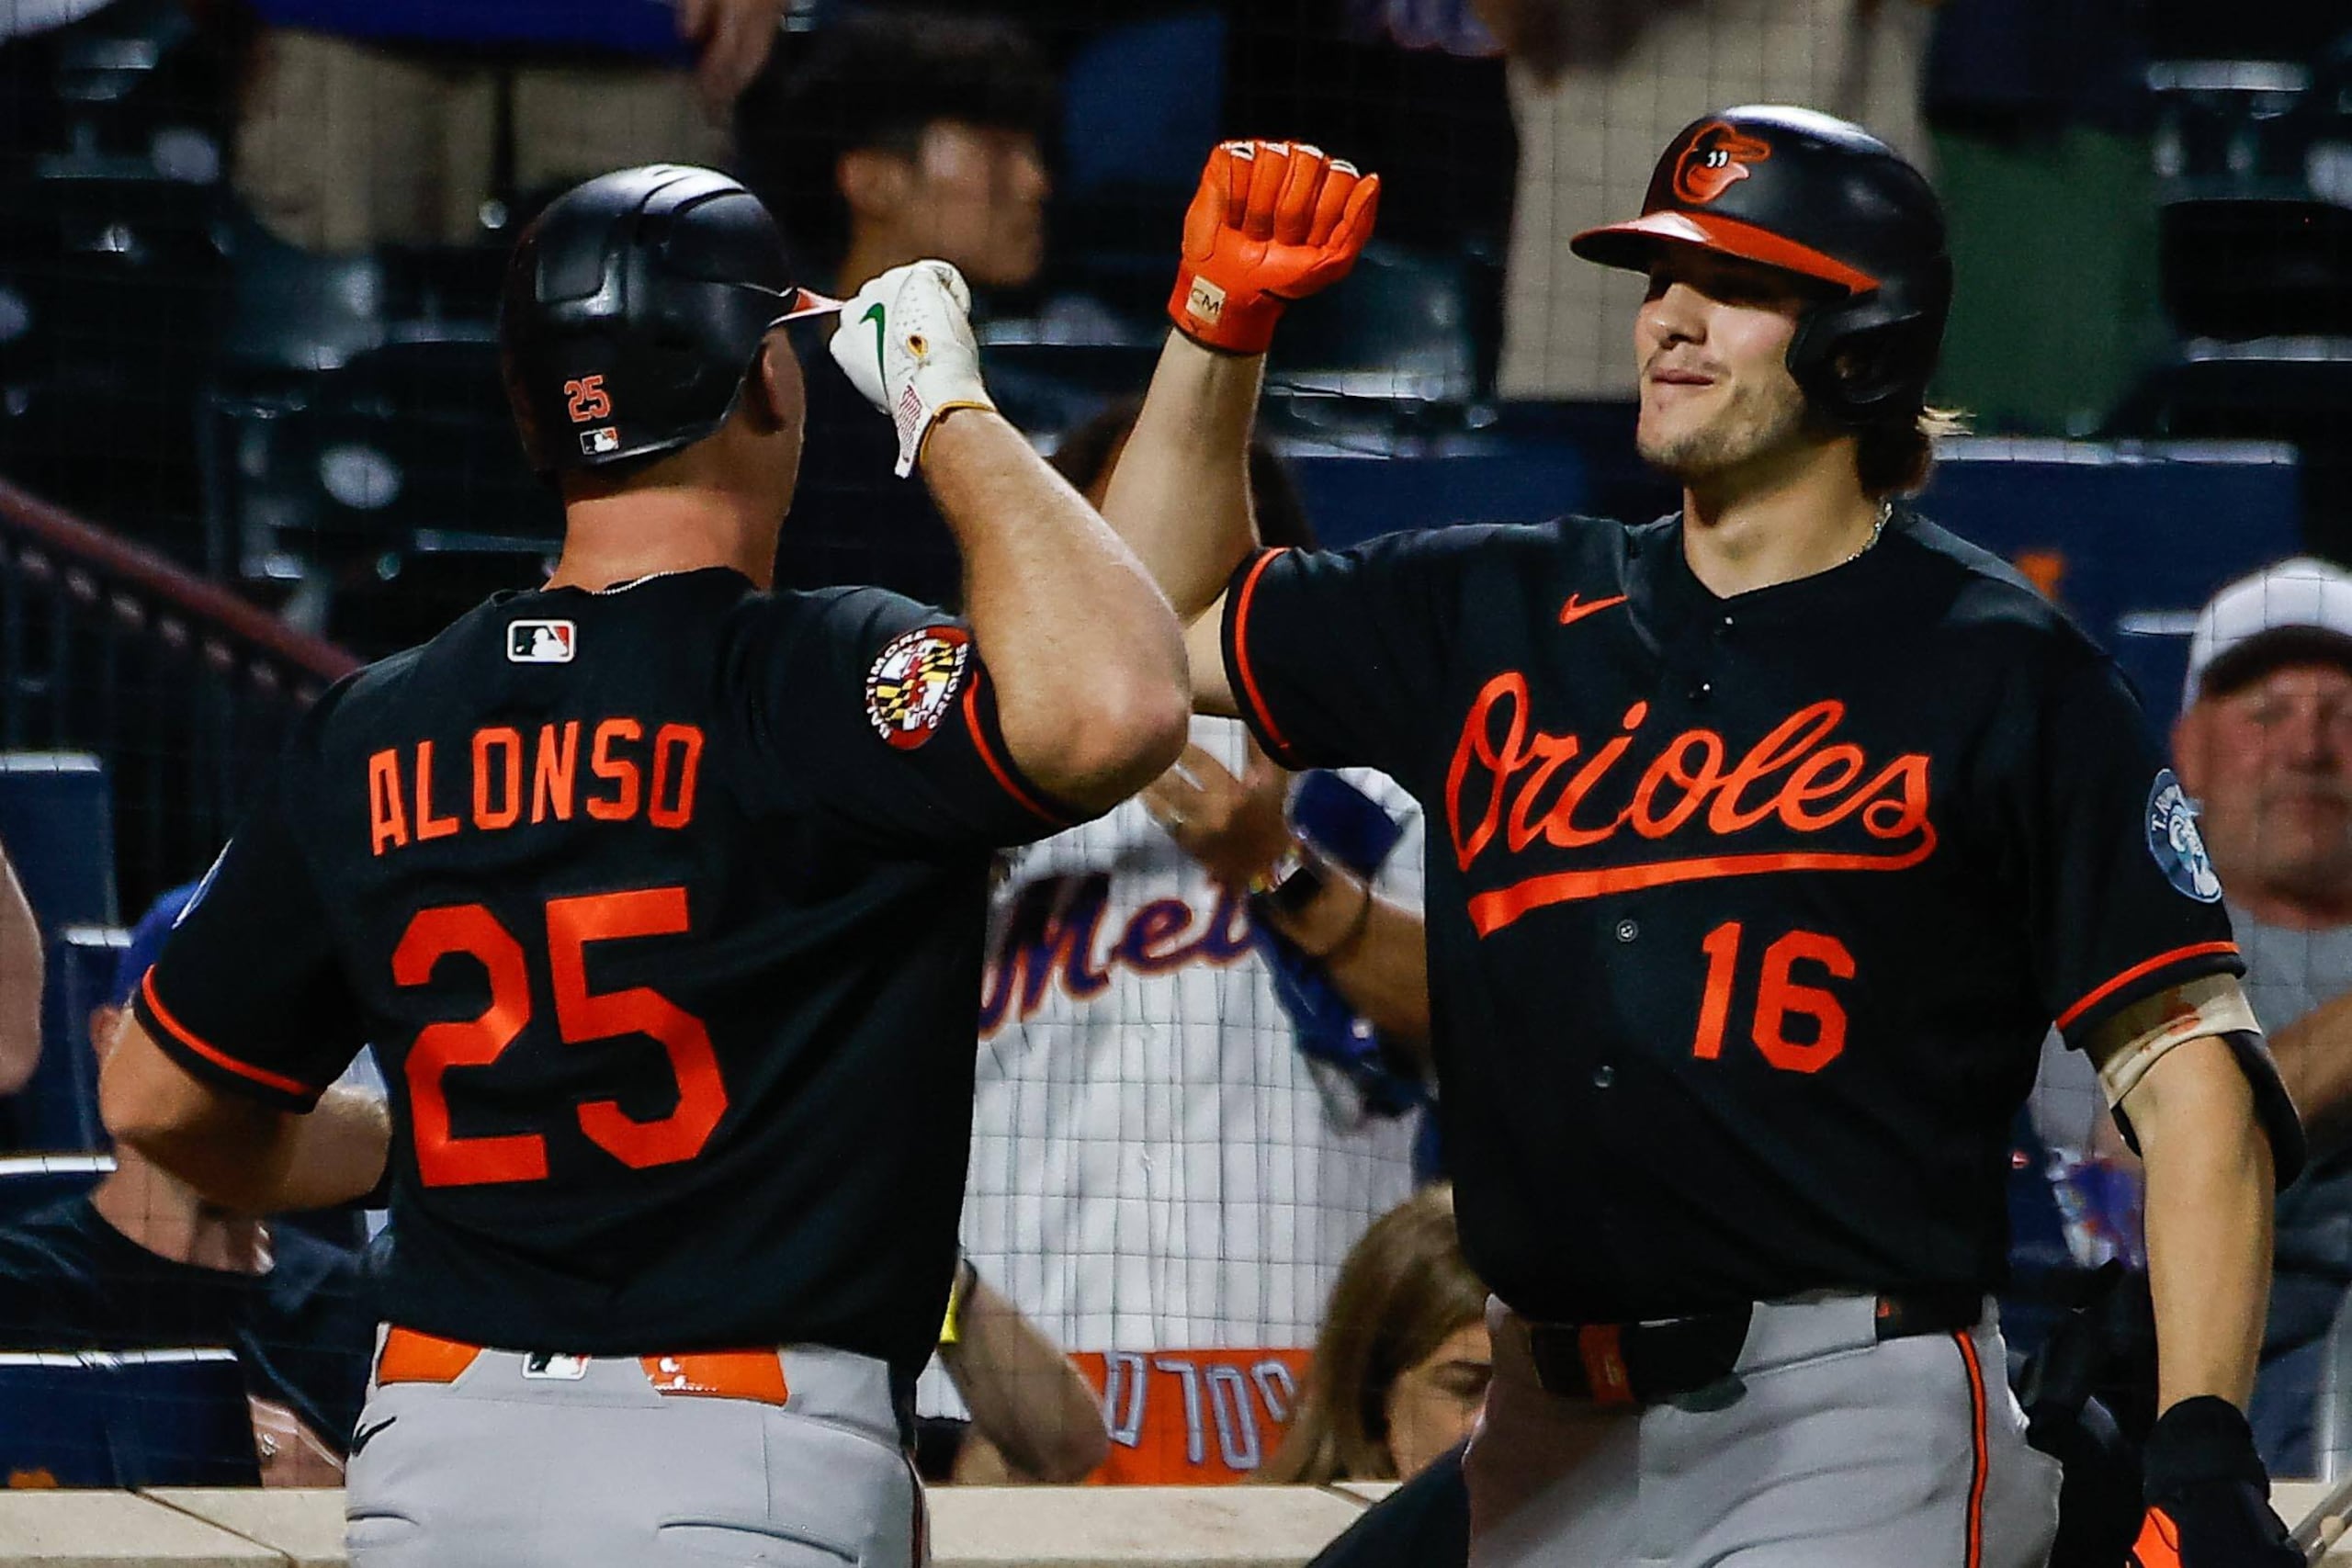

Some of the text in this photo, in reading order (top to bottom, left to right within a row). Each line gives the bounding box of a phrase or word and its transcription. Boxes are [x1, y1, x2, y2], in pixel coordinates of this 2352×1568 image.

[563, 375, 611, 423] 25
[928, 642, 968, 729] ORIOLES
[369, 717, 704, 856] ALONSO
[1445, 671, 1936, 886] Orioles
[391, 886, 729, 1186] 25
[1692, 921, 1856, 1074] 16
